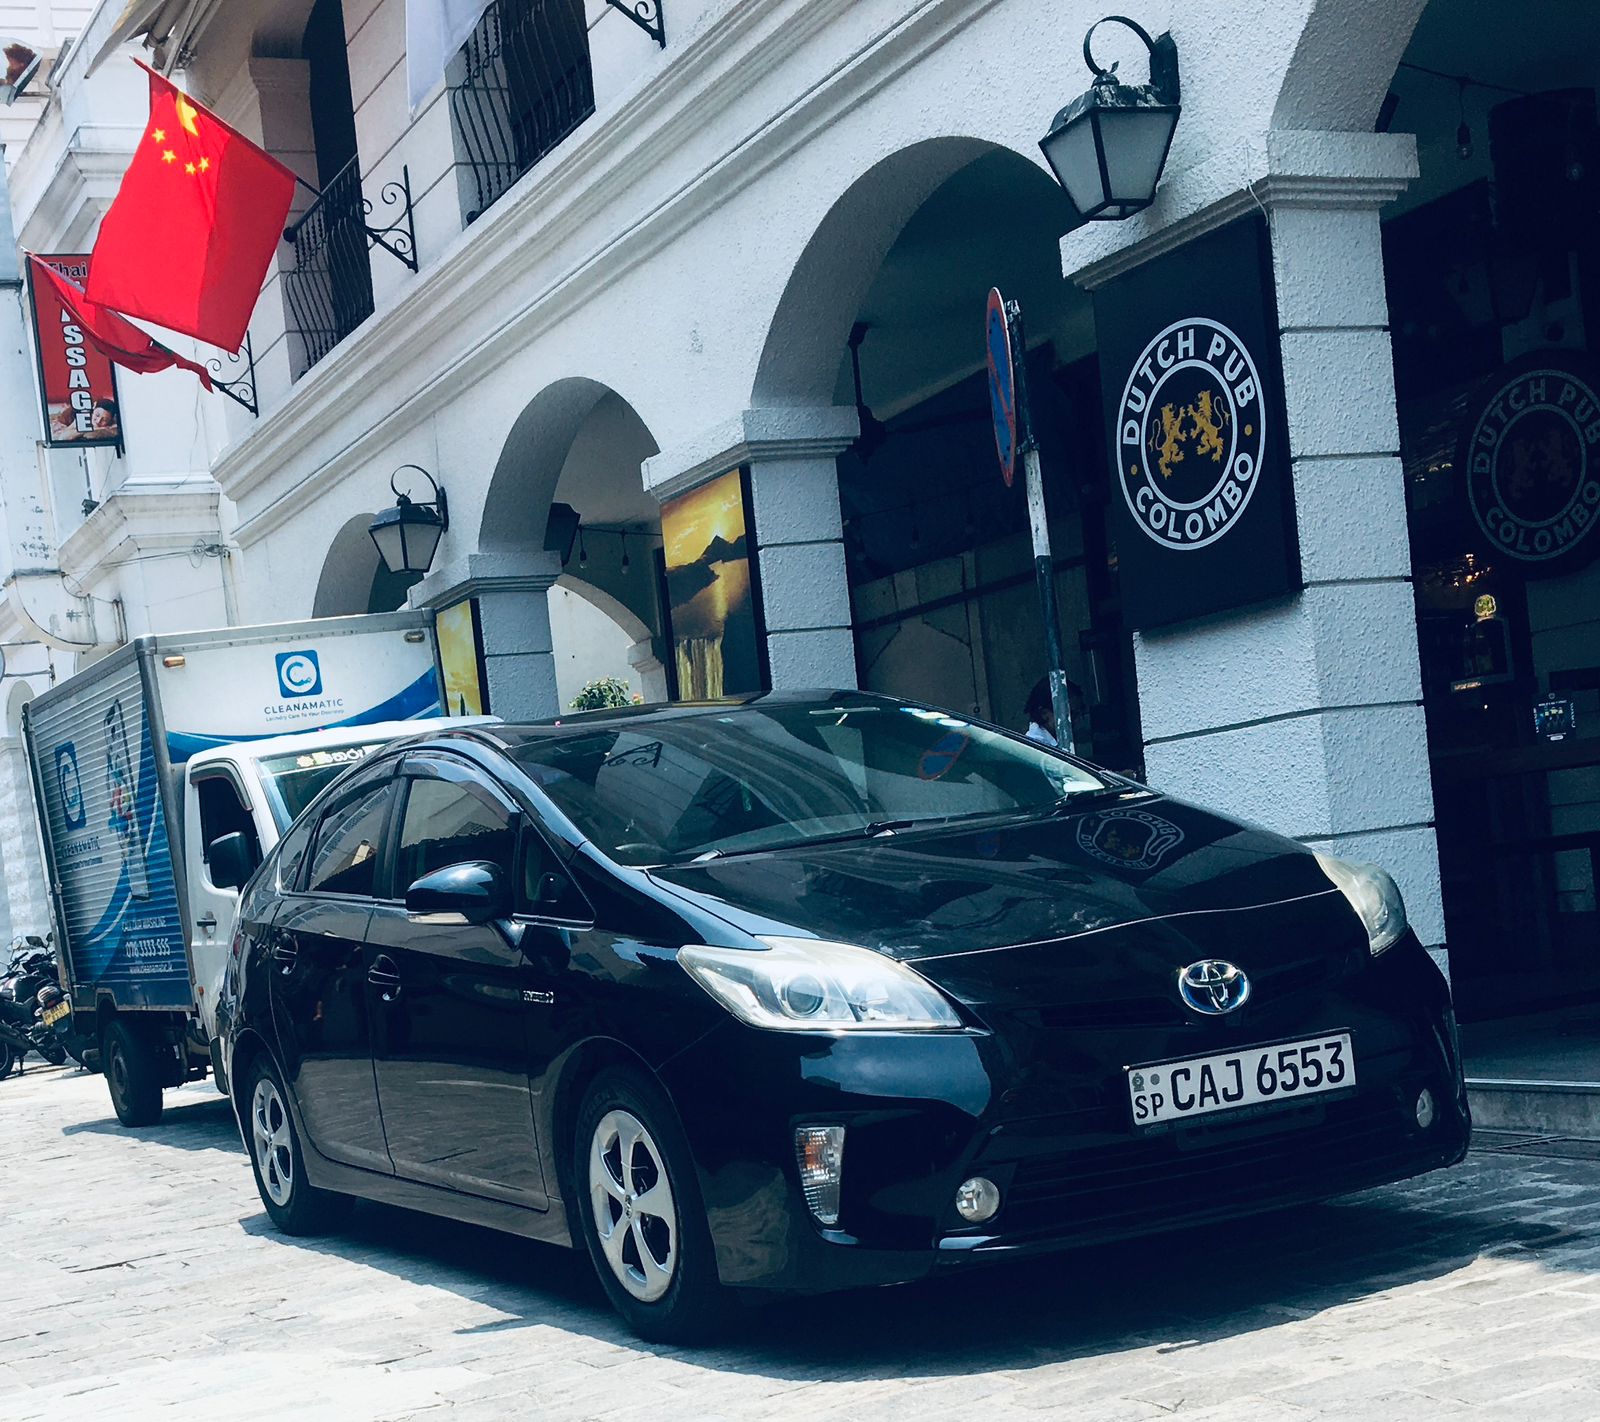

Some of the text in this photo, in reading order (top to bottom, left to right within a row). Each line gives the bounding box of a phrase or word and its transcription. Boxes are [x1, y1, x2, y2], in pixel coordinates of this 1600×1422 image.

[60, 281, 94, 432] SSAGE
[1123, 328, 1256, 445] DUTCH PUB
[1473, 379, 1546, 474] DUTCH
[1136, 452, 1254, 540] COLOMBO
[1486, 481, 1600, 552] COLOMBO
[264, 698, 344, 714] CLEANAMATIC
[1134, 1092, 1164, 1119] SP
[1170, 1041, 1345, 1111] CAJ 6553
